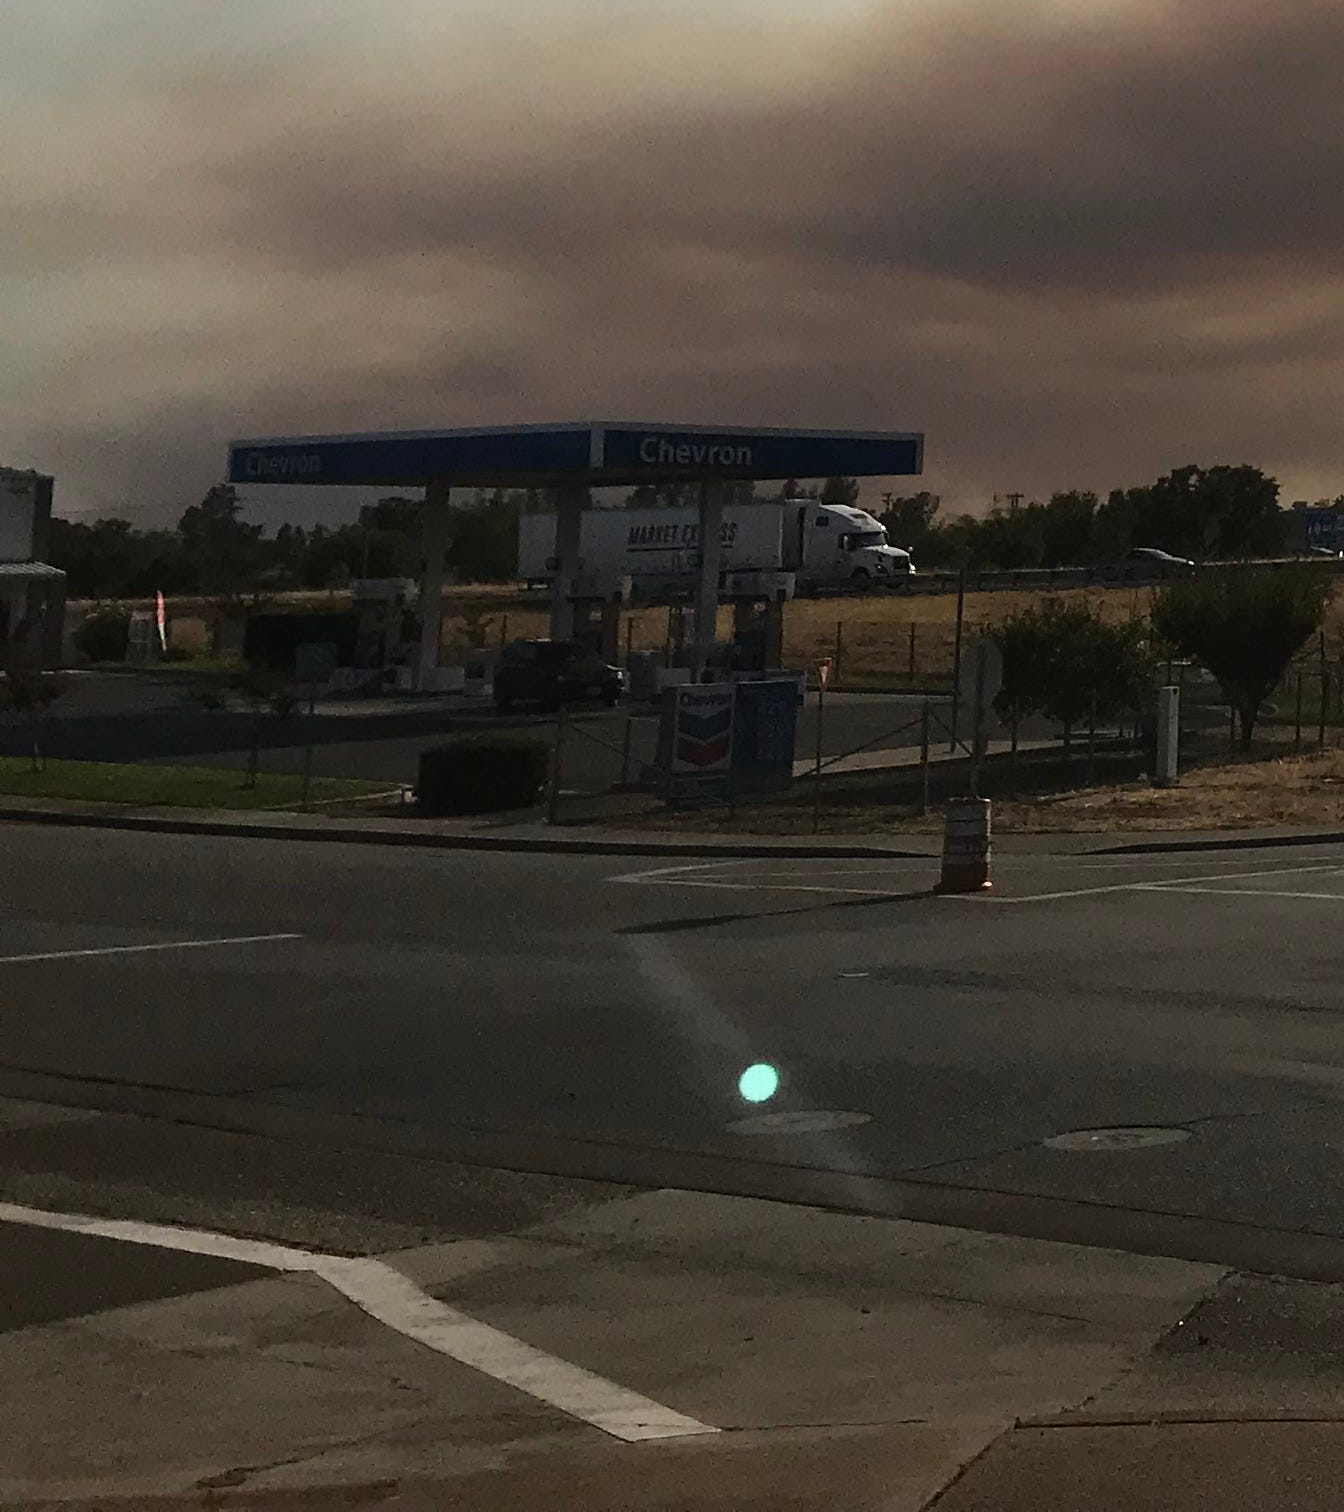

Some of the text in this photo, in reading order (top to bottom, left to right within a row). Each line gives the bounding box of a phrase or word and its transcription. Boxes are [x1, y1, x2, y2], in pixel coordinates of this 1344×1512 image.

[640, 438, 752, 465] Chevron
[246, 452, 320, 476] Chevron
[628, 522, 738, 545] MARKET EXSS
[680, 693, 730, 706] Chevron
